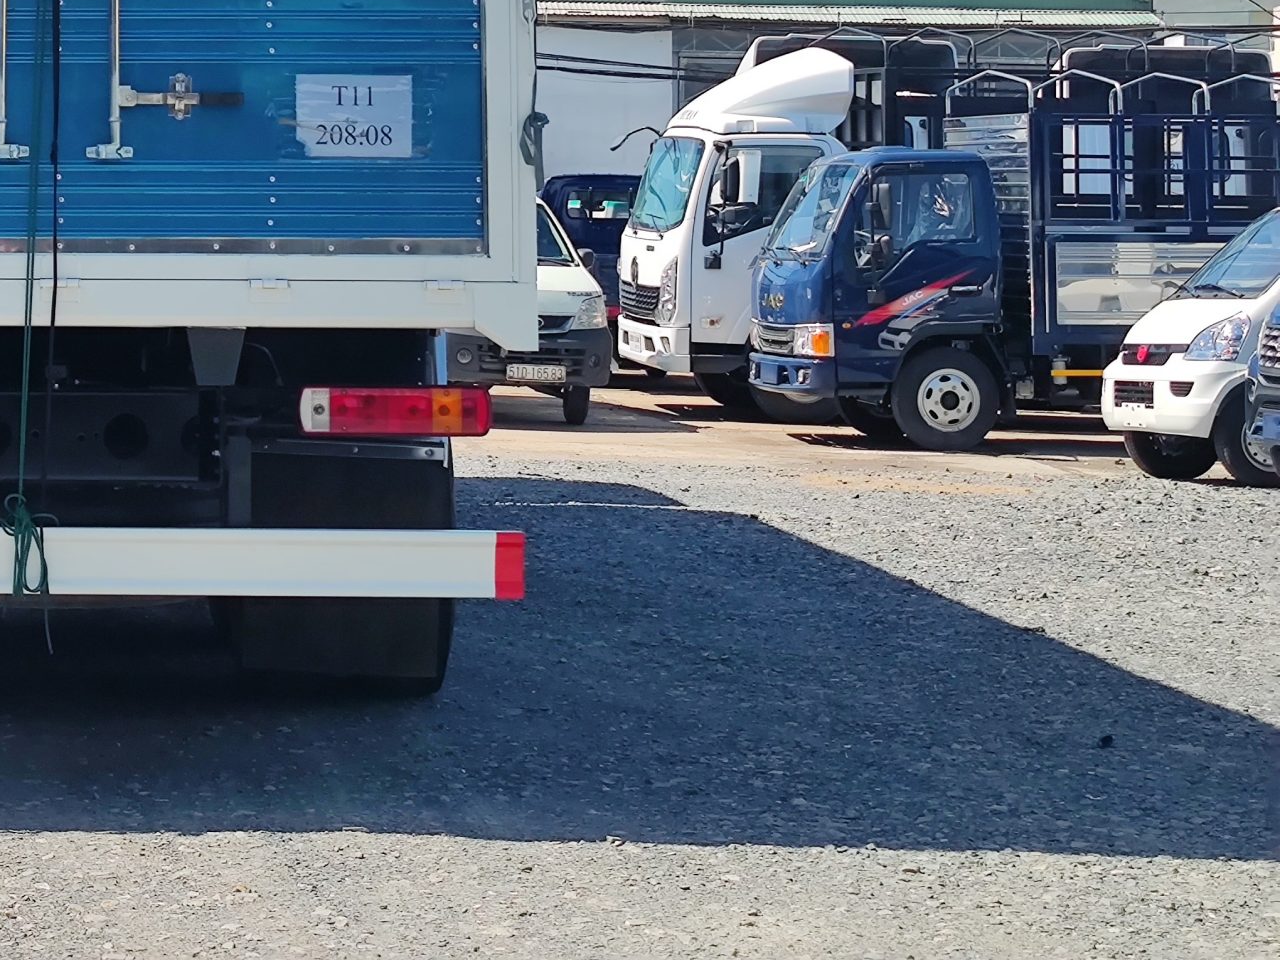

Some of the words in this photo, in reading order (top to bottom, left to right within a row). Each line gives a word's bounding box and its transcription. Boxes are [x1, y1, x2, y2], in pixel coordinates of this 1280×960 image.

[332, 85, 374, 107] T11
[315, 123, 393, 146] 208.08
[762, 293, 785, 310] JAC
[902, 291, 924, 306] JAC
